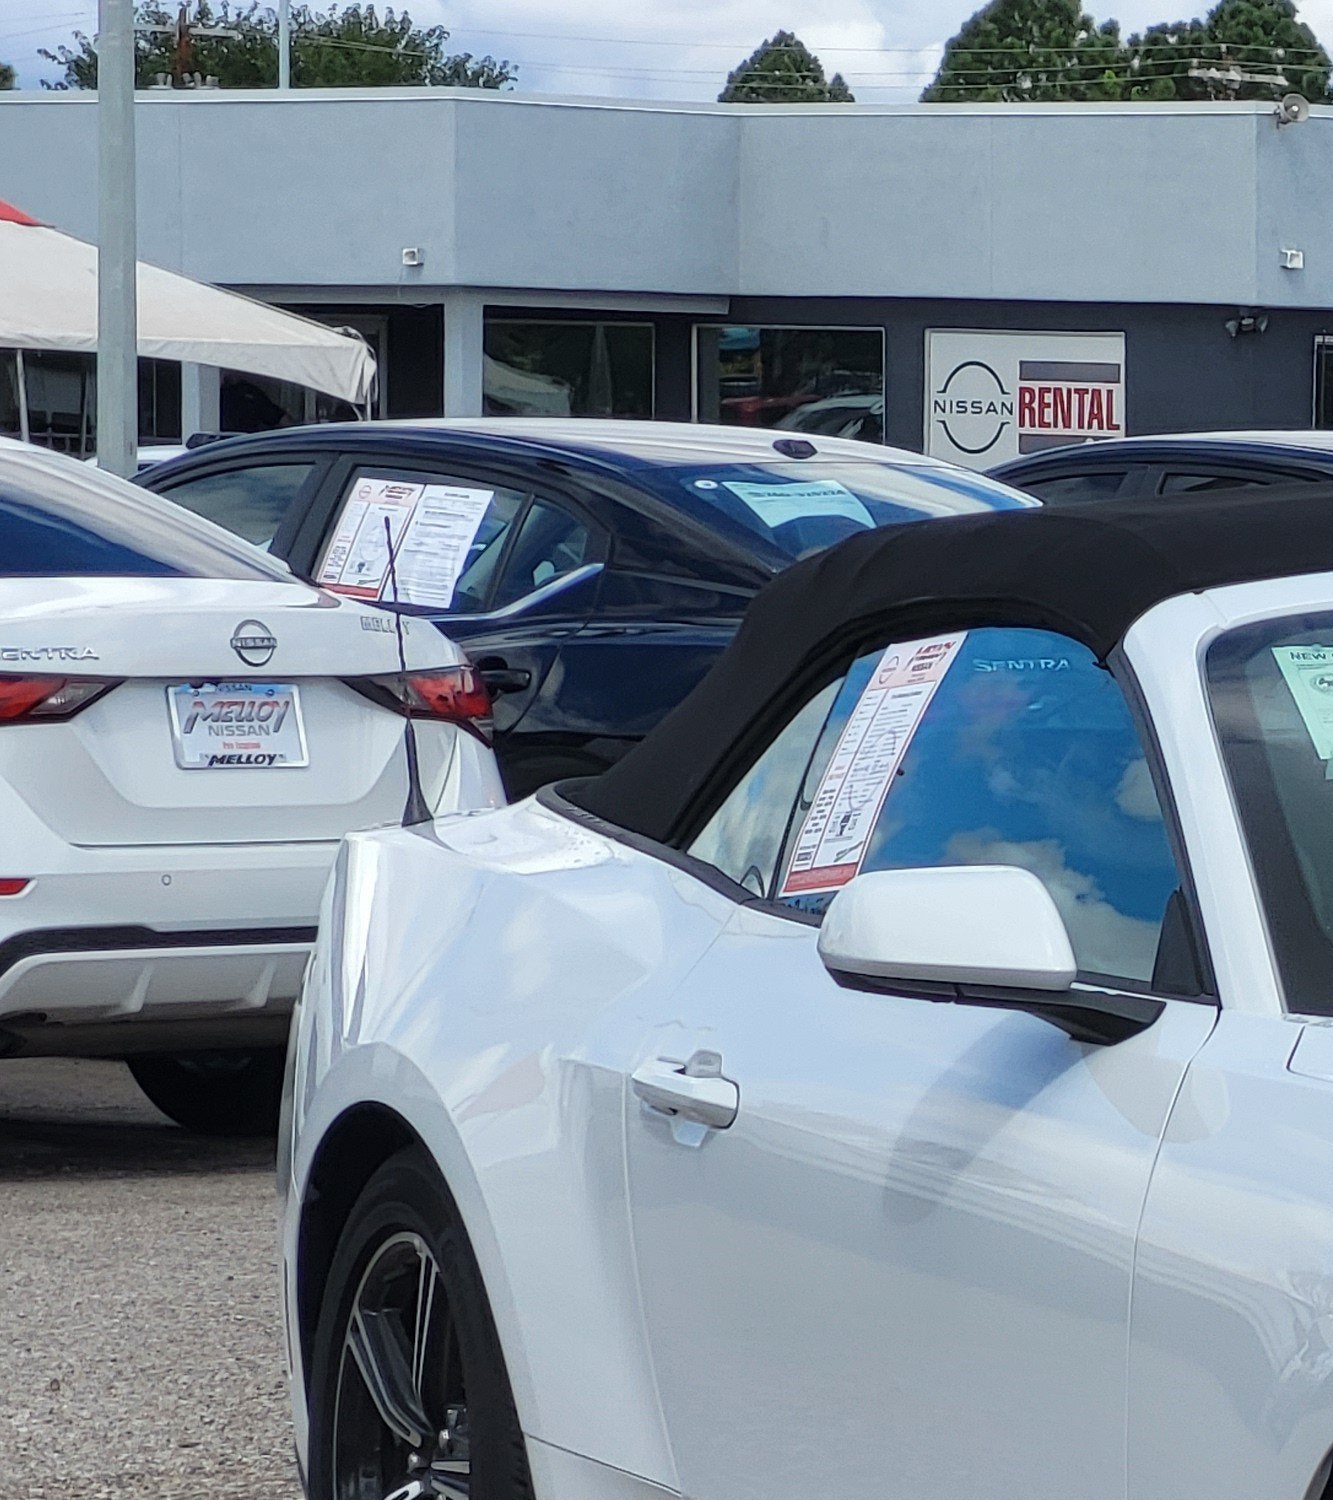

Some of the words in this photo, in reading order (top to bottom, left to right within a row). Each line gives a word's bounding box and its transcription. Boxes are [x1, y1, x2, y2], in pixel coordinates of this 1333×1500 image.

[933, 399, 1014, 416] NISSAN
[1018, 386, 1121, 431] RENTAL
[360, 615, 410, 635] MELLY
[0, 647, 100, 660] ENTRA
[1289, 651, 1326, 661] NEW
[183, 700, 290, 734] MELLOY
[207, 724, 270, 736] NISSAN
[205, 753, 277, 767] MELLOY
